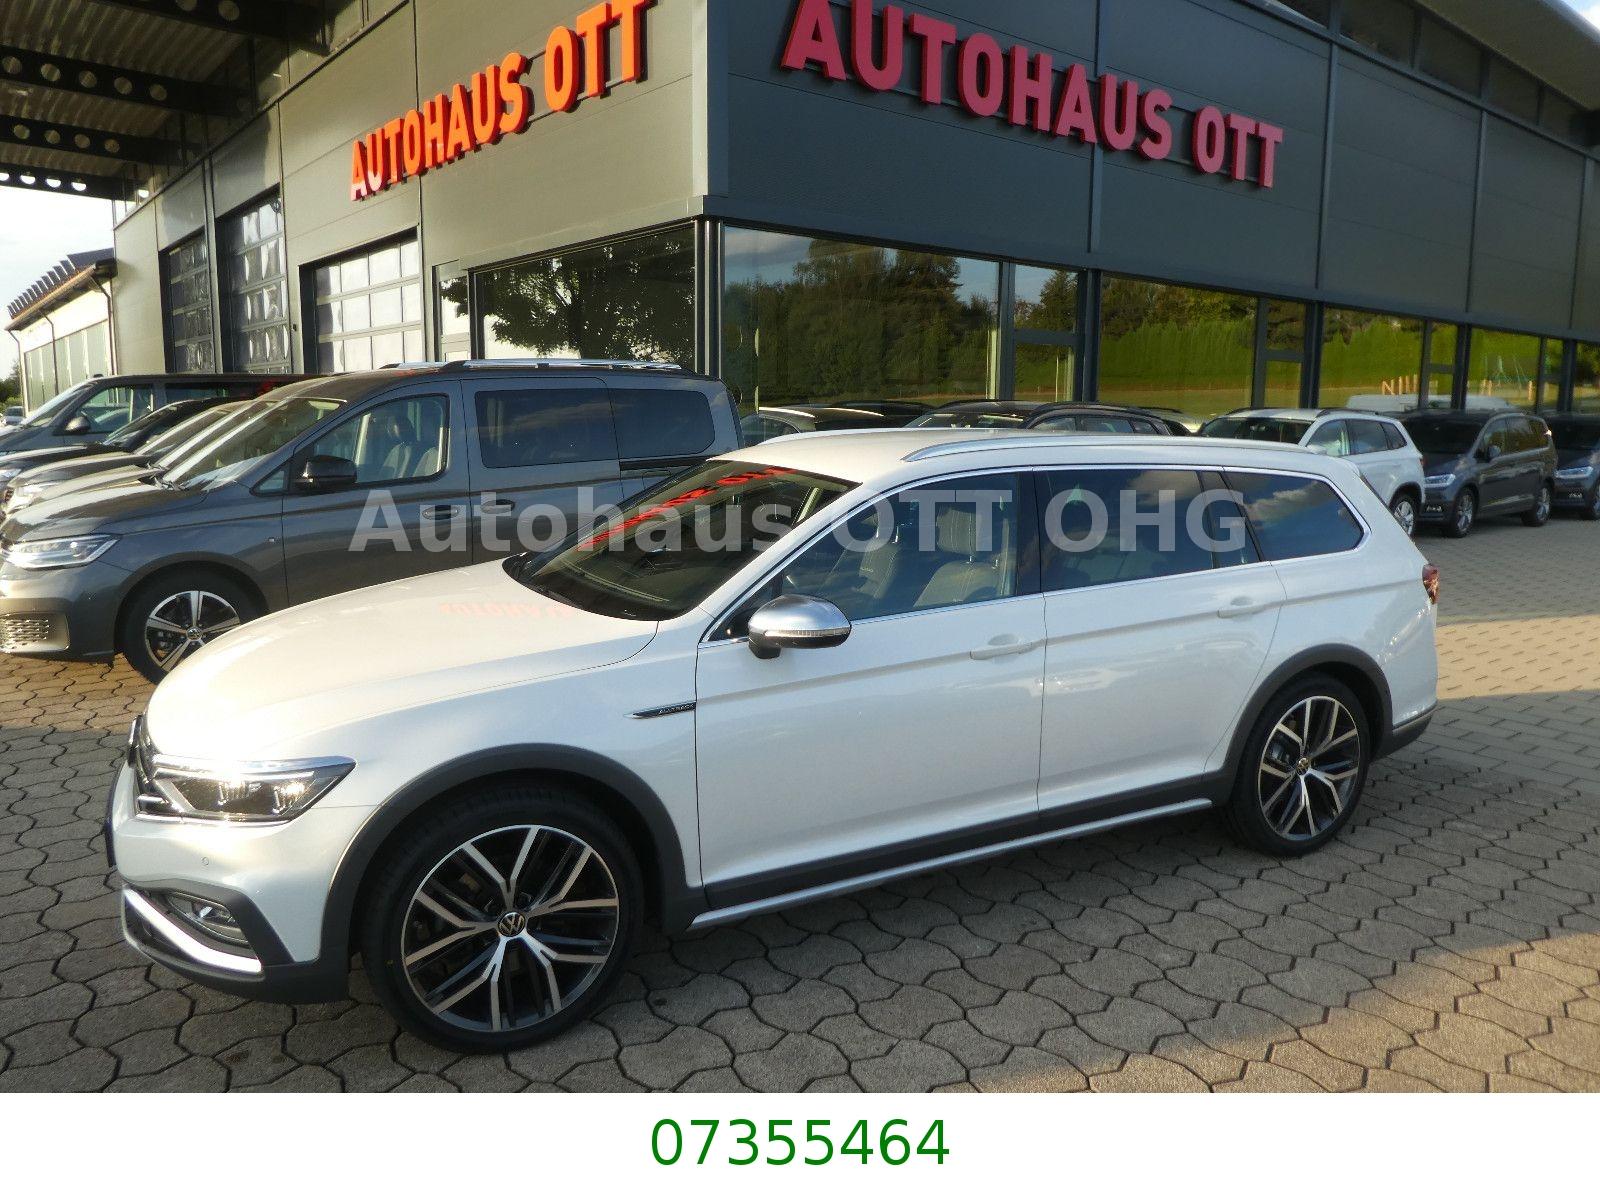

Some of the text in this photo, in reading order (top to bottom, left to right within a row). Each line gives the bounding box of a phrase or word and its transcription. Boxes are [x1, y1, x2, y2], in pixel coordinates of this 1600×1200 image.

[351, 0, 645, 201] AUTOHAUS OTT
[781, 0, 1283, 188] AUTOHAUS OTT
